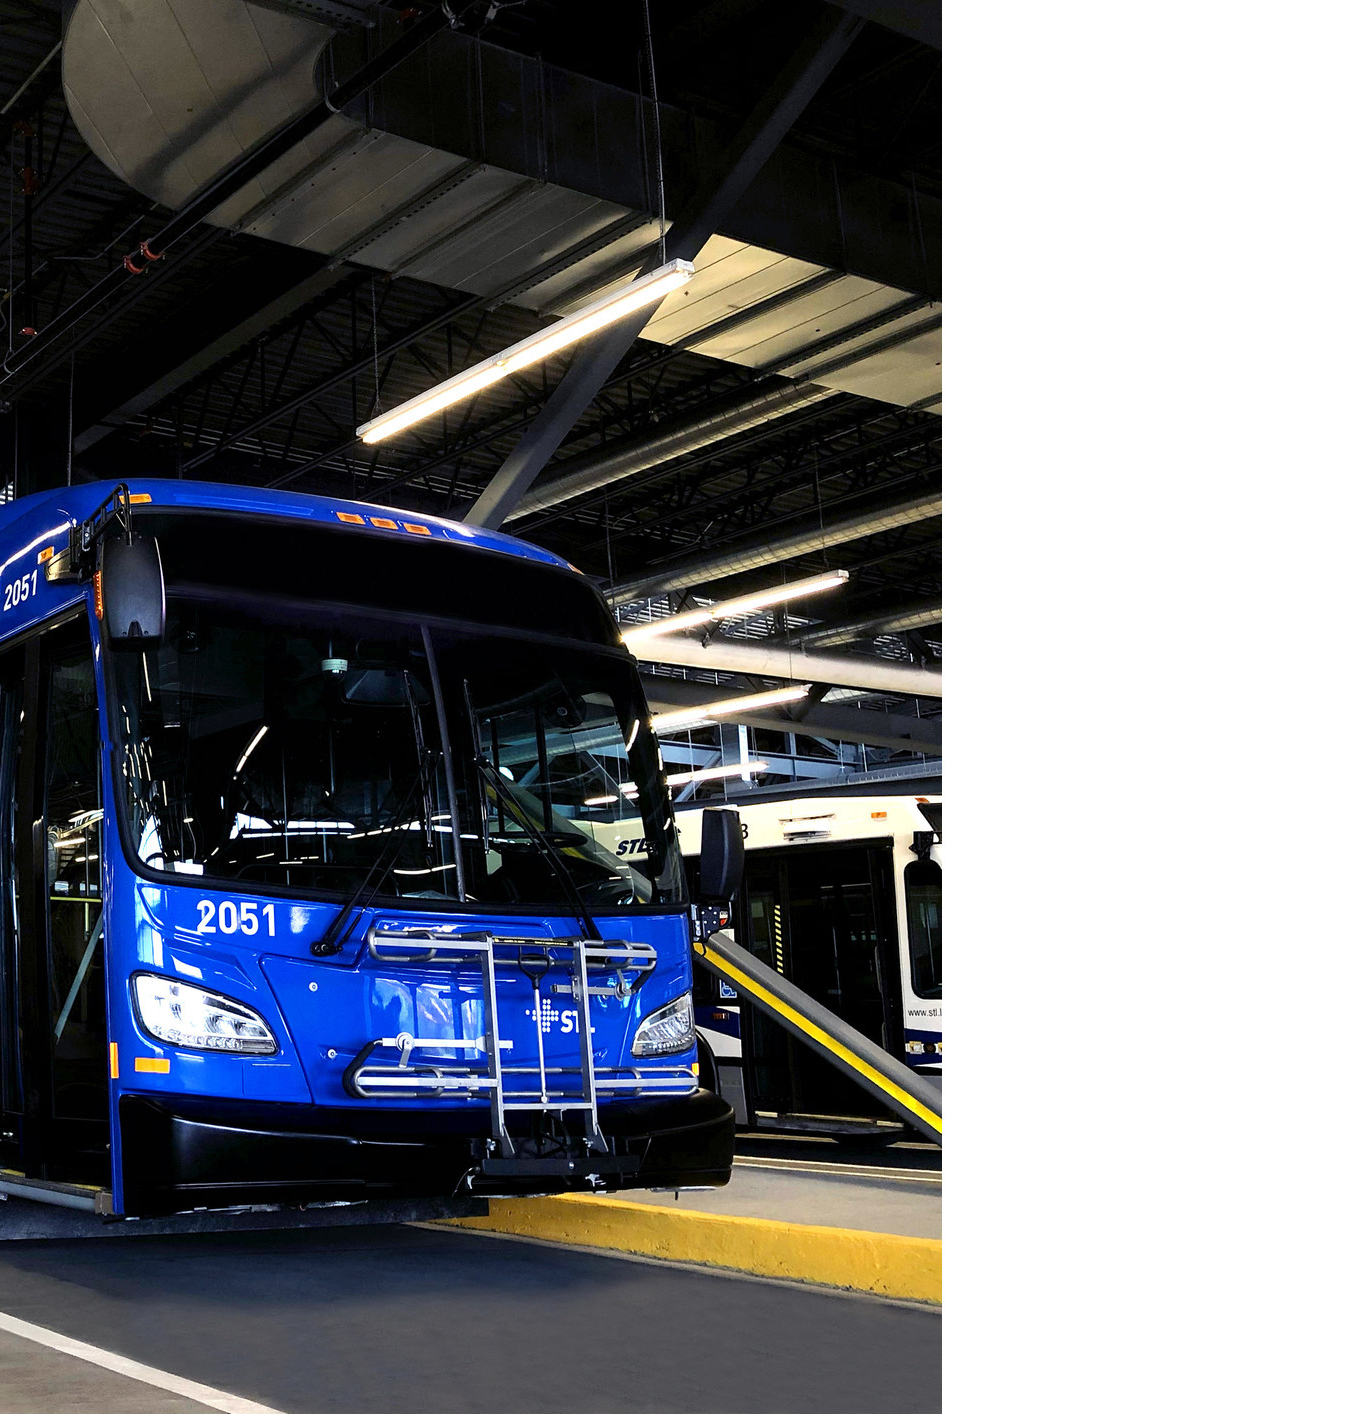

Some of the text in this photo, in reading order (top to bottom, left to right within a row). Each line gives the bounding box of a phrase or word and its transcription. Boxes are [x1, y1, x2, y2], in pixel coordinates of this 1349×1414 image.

[3, 569, 38, 611] 2051
[196, 899, 276, 937] 2051
[560, 1010, 596, 1033] ST
